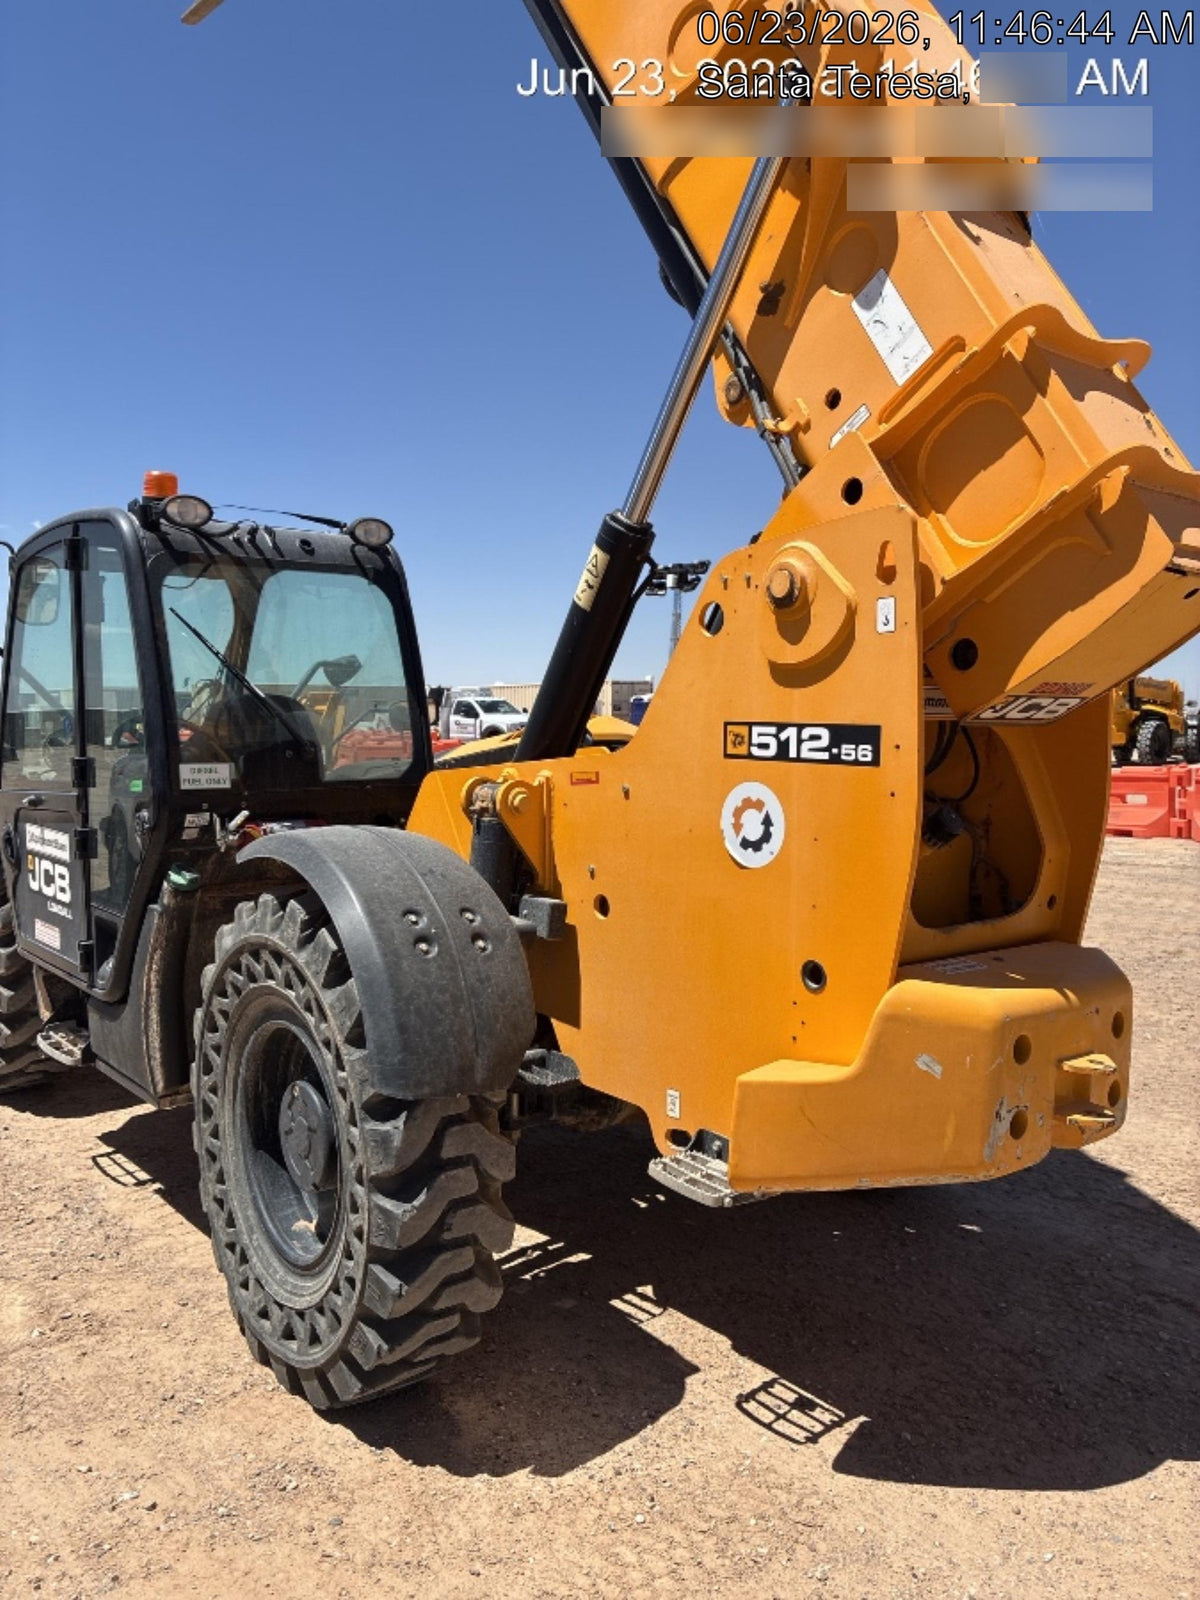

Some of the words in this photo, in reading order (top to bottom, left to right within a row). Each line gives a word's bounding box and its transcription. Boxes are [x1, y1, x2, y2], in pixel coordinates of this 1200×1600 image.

[979, 697, 1084, 719] JCB
[750, 724, 873, 762] 512-56
[28, 857, 72, 904] JCB
